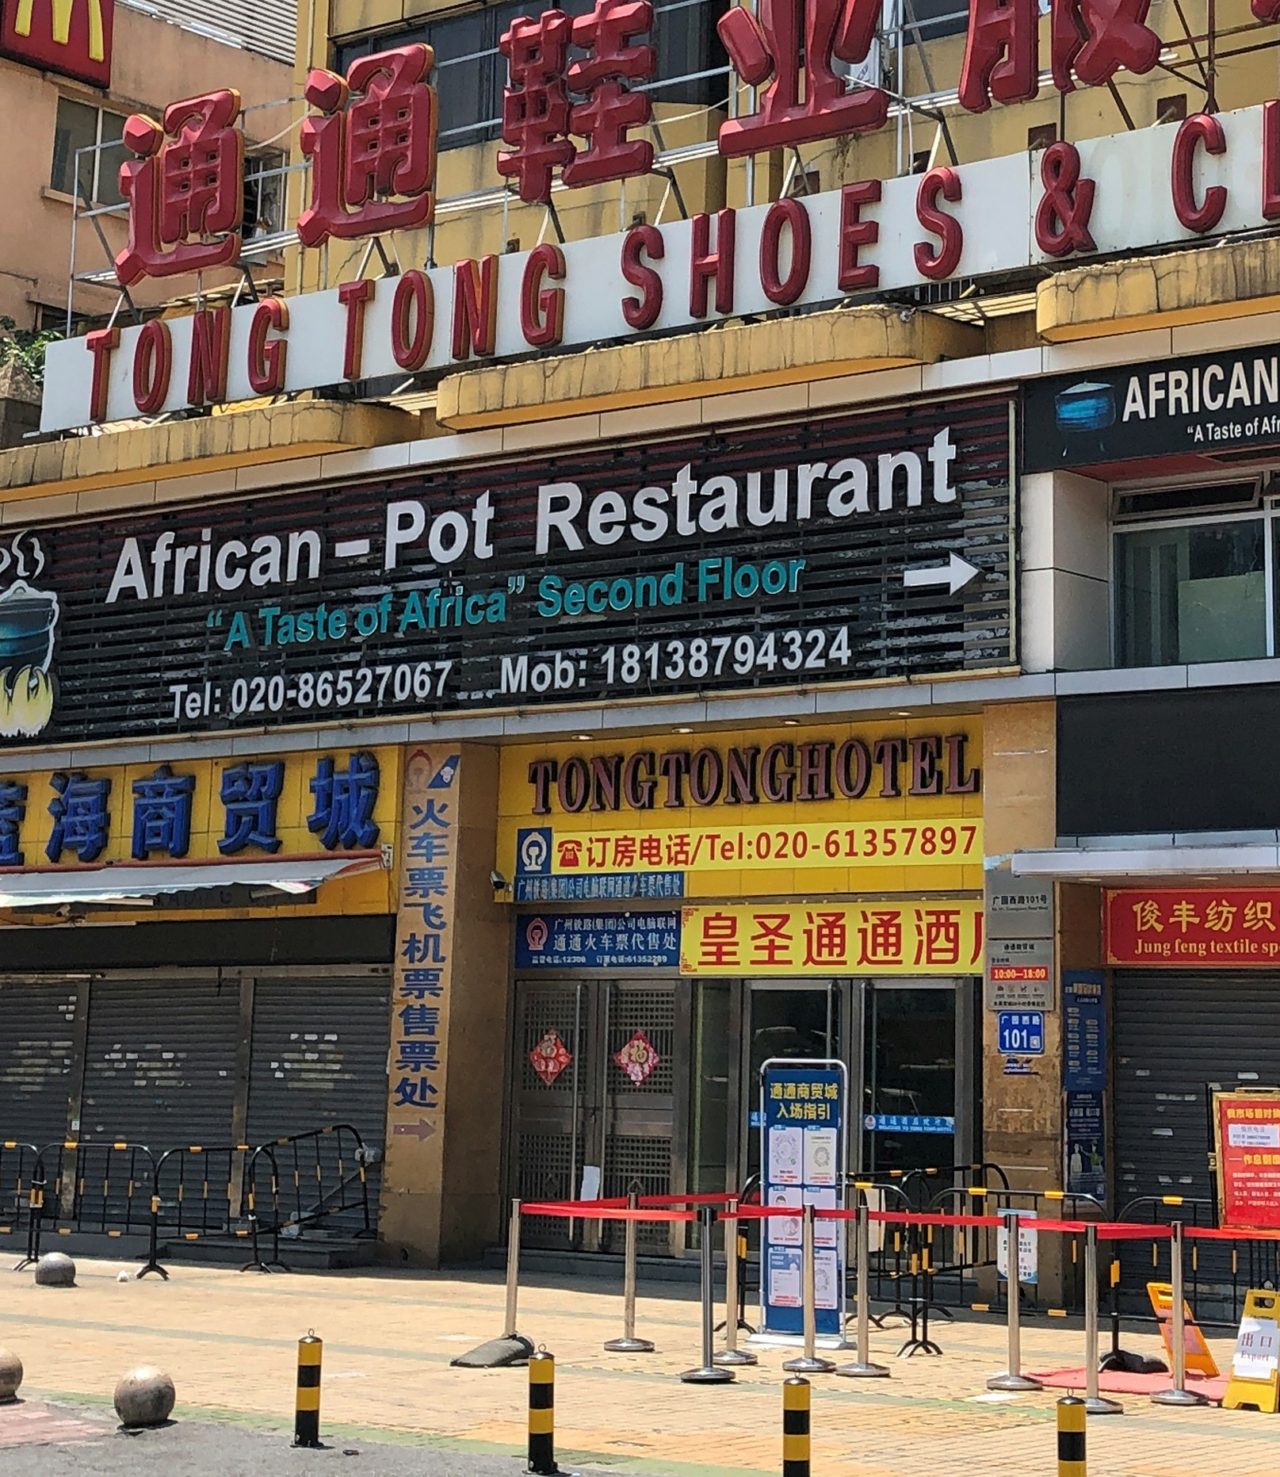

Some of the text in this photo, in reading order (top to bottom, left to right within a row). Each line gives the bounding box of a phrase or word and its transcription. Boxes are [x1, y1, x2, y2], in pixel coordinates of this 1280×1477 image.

[86, 298, 289, 421] TONG
[338, 243, 566, 380] TONG
[622, 166, 963, 331] SHOES
[1035, 140, 1097, 257] &
[1206, 422, 1242, 441] Taste
[1245, 417, 1259, 436] of
[535, 426, 957, 556] Restaurant
[258, 605, 348, 647] Taste
[357, 593, 395, 638] of
[537, 562, 684, 619] Second
[698, 557, 806, 600] Floor
[169, 626, 852, 720] Tel: 020-86527067 Mob: 18138794324
[393, 798, 452, 1109] 火车票飞机票售票处
[553, 932, 677, 952] 通通火车票代售处
[697, 908, 983, 968] 皇圣通通酒
[1134, 938, 1171, 957] Jung
[1174, 938, 1207, 957] feng
[1210, 937, 1258, 955] textile
[1003, 1028, 1027, 1049] 101
[770, 1082, 838, 1100] 通通商贸城
[776, 1102, 830, 1120] 入场指引
